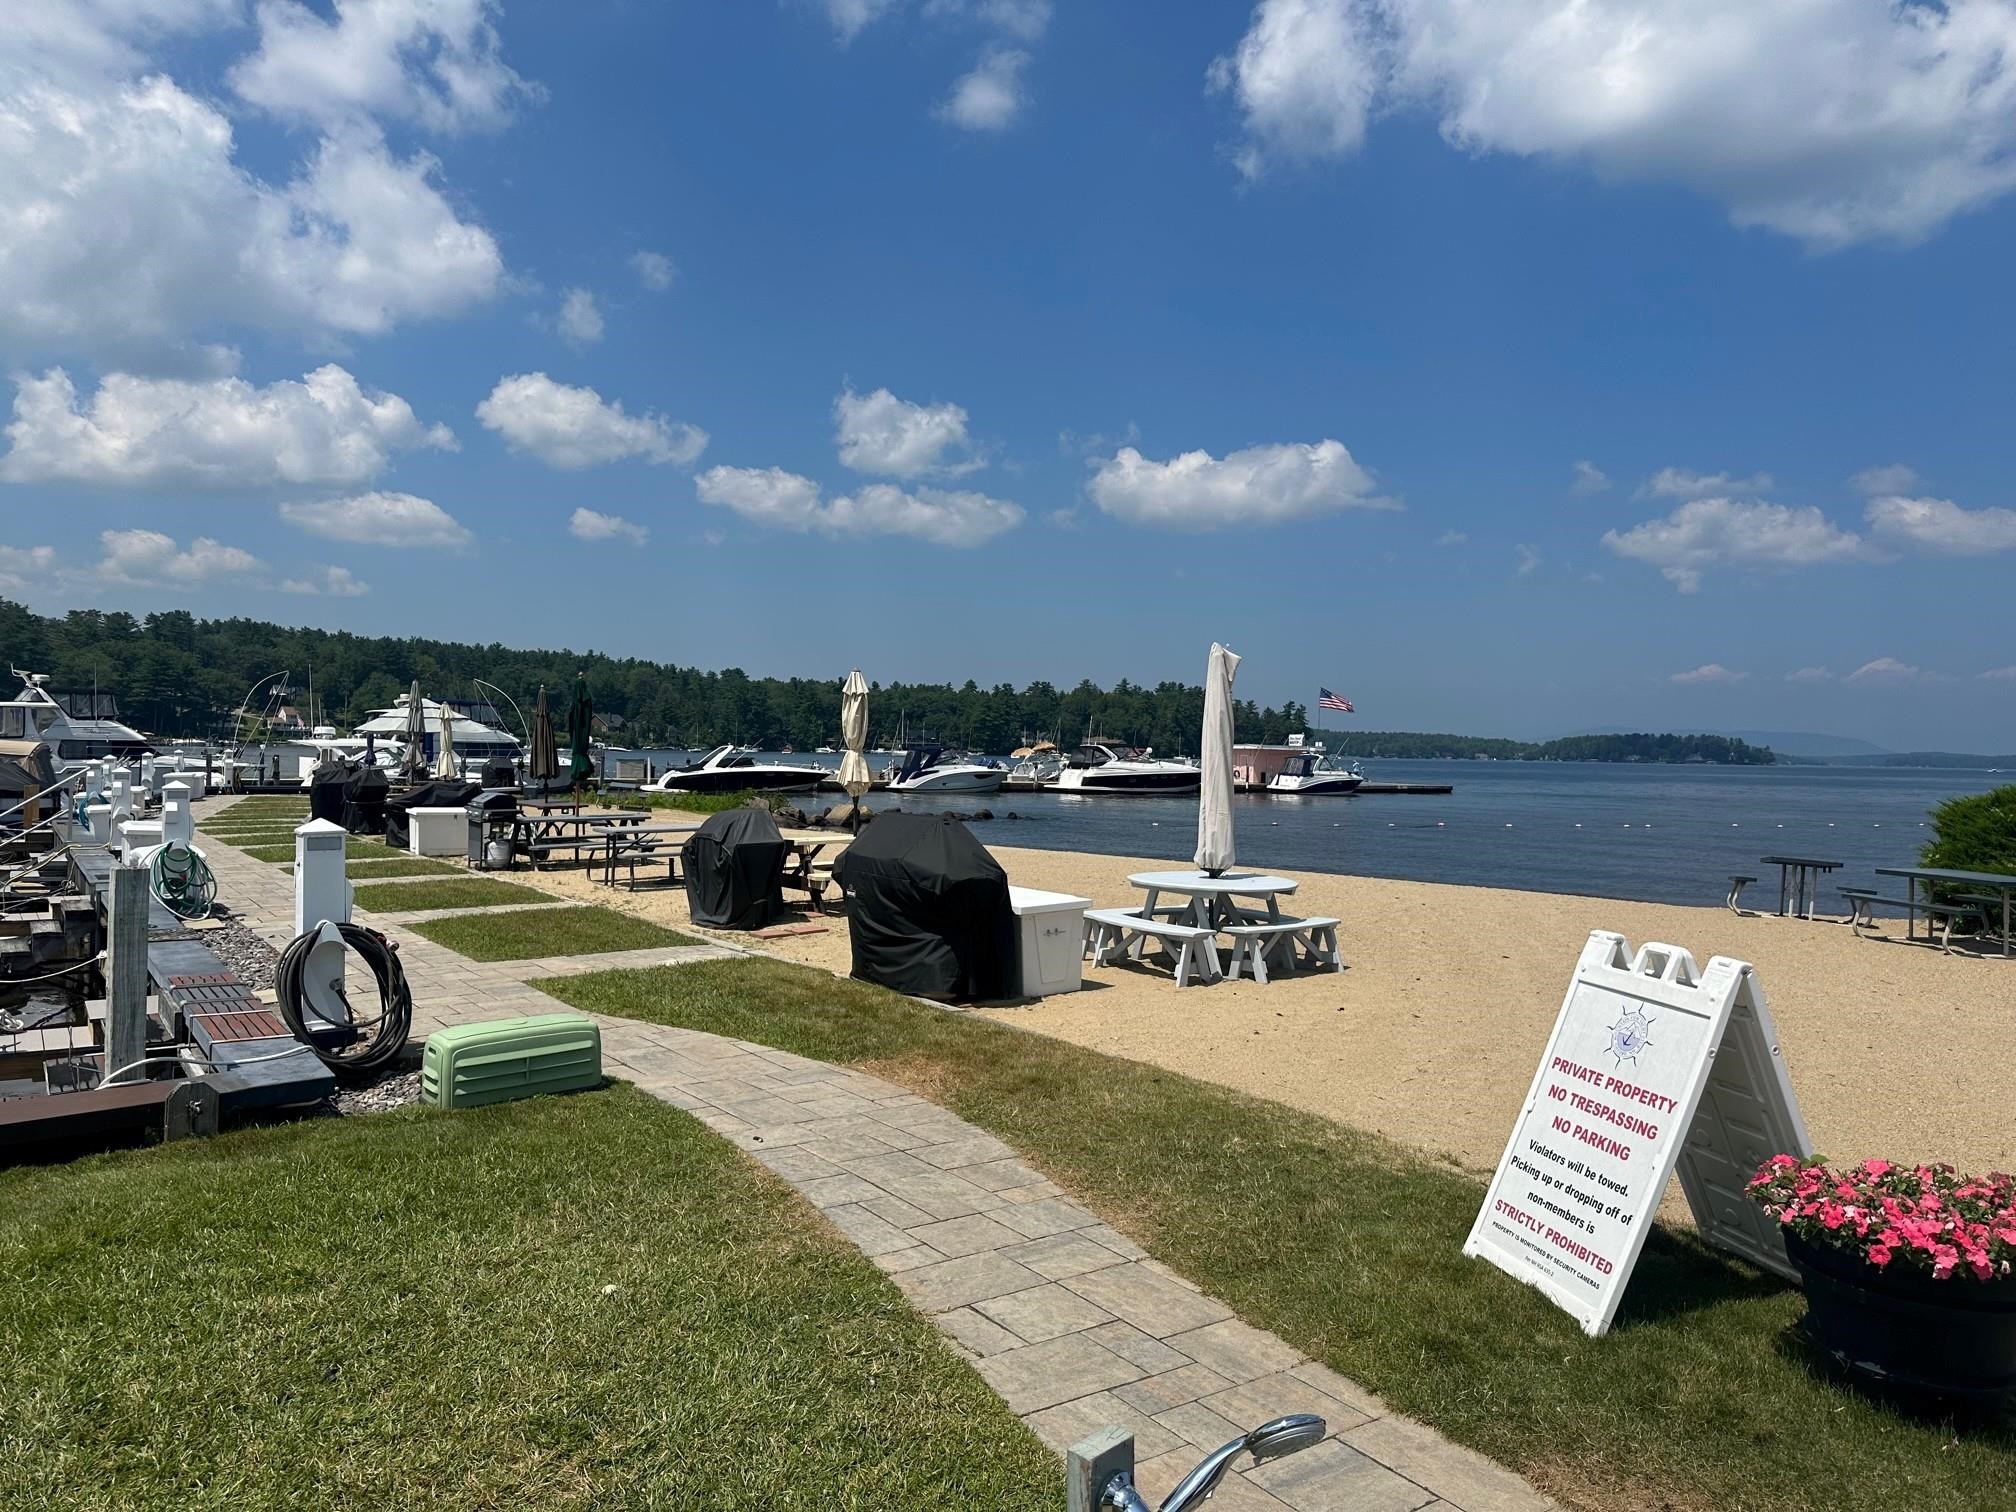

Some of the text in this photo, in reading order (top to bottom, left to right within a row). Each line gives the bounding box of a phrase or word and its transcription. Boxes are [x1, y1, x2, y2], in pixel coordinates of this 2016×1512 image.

[1548, 1084, 1658, 1140] NO TRESPASSING
[1552, 1057, 1678, 1114] PRIVATE PROPERTY
[1552, 1116, 1631, 1160] NO PARKING
[1510, 1155, 1633, 1226] Picking up or dropping off of
[1529, 1139, 1628, 1197] Violators will be towed.
[1495, 1199, 1613, 1275] STRICTLY PROHIBITED
[1527, 1192, 1595, 1234] non-members is
[1492, 1221, 1515, 1237] PROPERTY
[1520, 1237, 1546, 1257] MONITORED
[1553, 1257, 1577, 1275] SECURITY
[1577, 1272, 1600, 1290] CAMERAS
